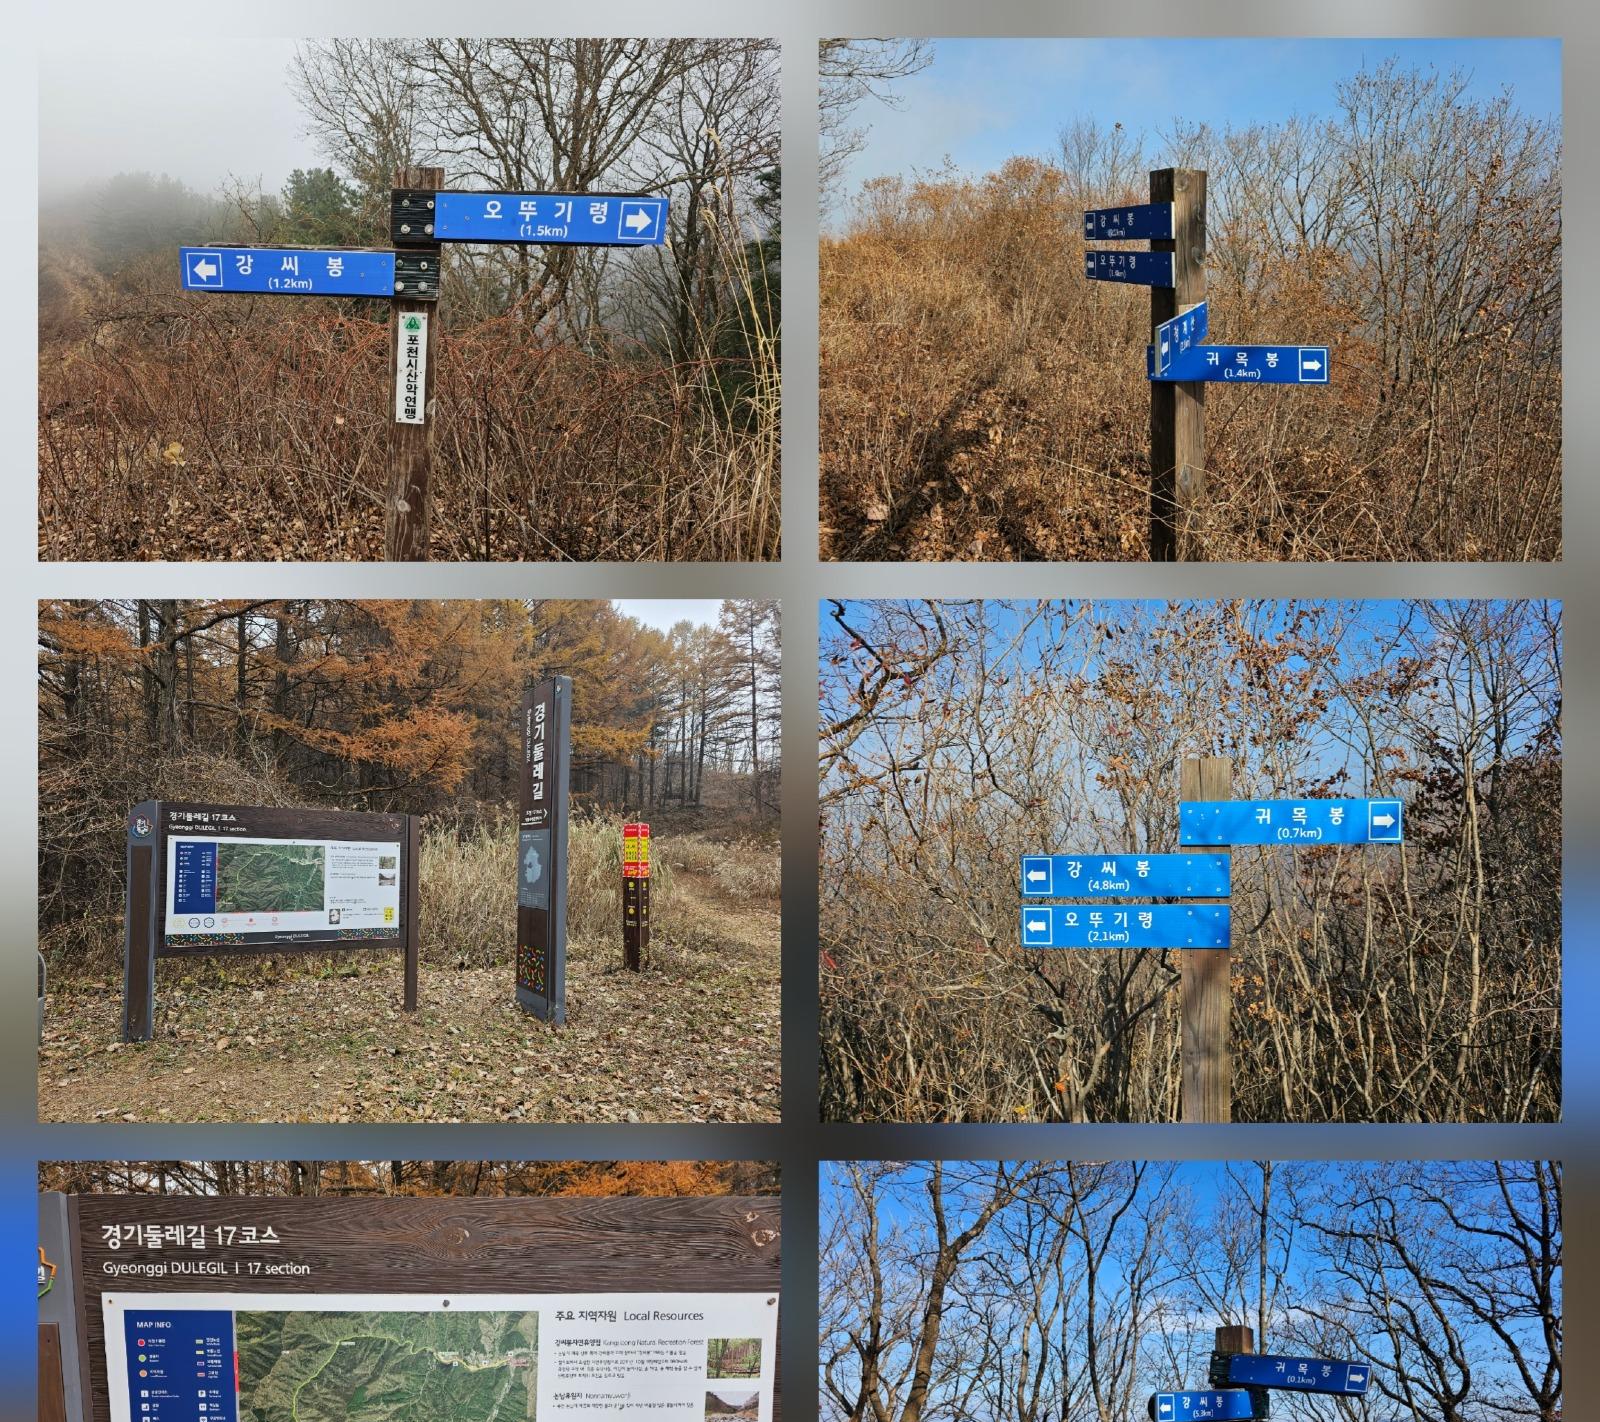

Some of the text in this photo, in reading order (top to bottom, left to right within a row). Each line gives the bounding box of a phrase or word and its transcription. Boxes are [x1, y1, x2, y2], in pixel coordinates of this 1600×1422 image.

[520, 224, 567, 239] (1.5km)
[268, 277, 312, 291] (1.2km)
[404, 334, 419, 420] 포천시산악연맹
[1224, 368, 1261, 379] (1.4km)
[533, 702, 545, 800] 경기둘레길
[1277, 826, 1322, 840] (0.7km)
[1088, 879, 1130, 892] (4.8km)
[1087, 930, 1130, 943] (2.1km)
[101, 1224, 280, 1250] 경기둘레길 17코스
[102, 1262, 310, 1277] Gyeonggi DULEGIL 17 section
[555, 1310, 617, 1322] 주요 지역자원
[623, 1311, 704, 1321] Local Resources
